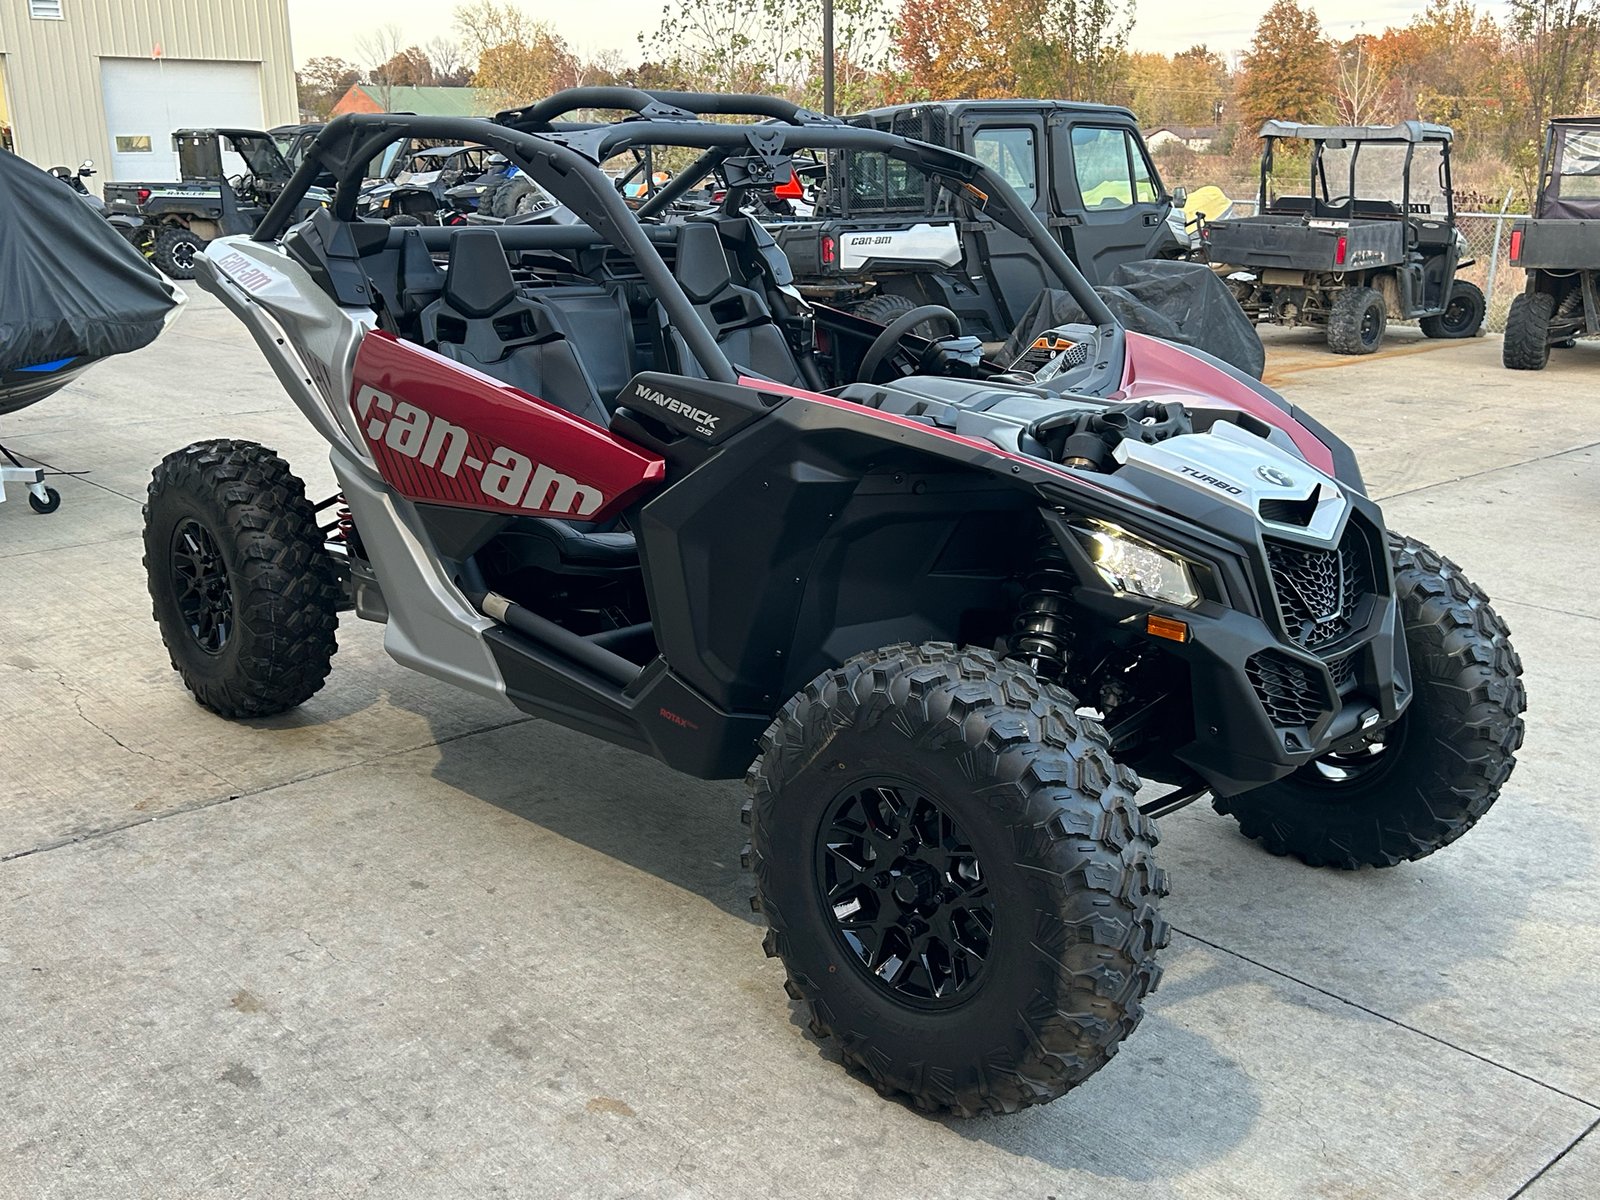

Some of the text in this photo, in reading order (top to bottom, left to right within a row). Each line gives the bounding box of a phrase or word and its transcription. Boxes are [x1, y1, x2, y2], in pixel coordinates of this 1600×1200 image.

[851, 236, 892, 246] can-am
[218, 252, 272, 292] can-am
[635, 383, 720, 429] MAVERICK
[695, 425, 713, 436] DS
[357, 384, 603, 516] can-am
[1181, 466, 1242, 495] TURBO
